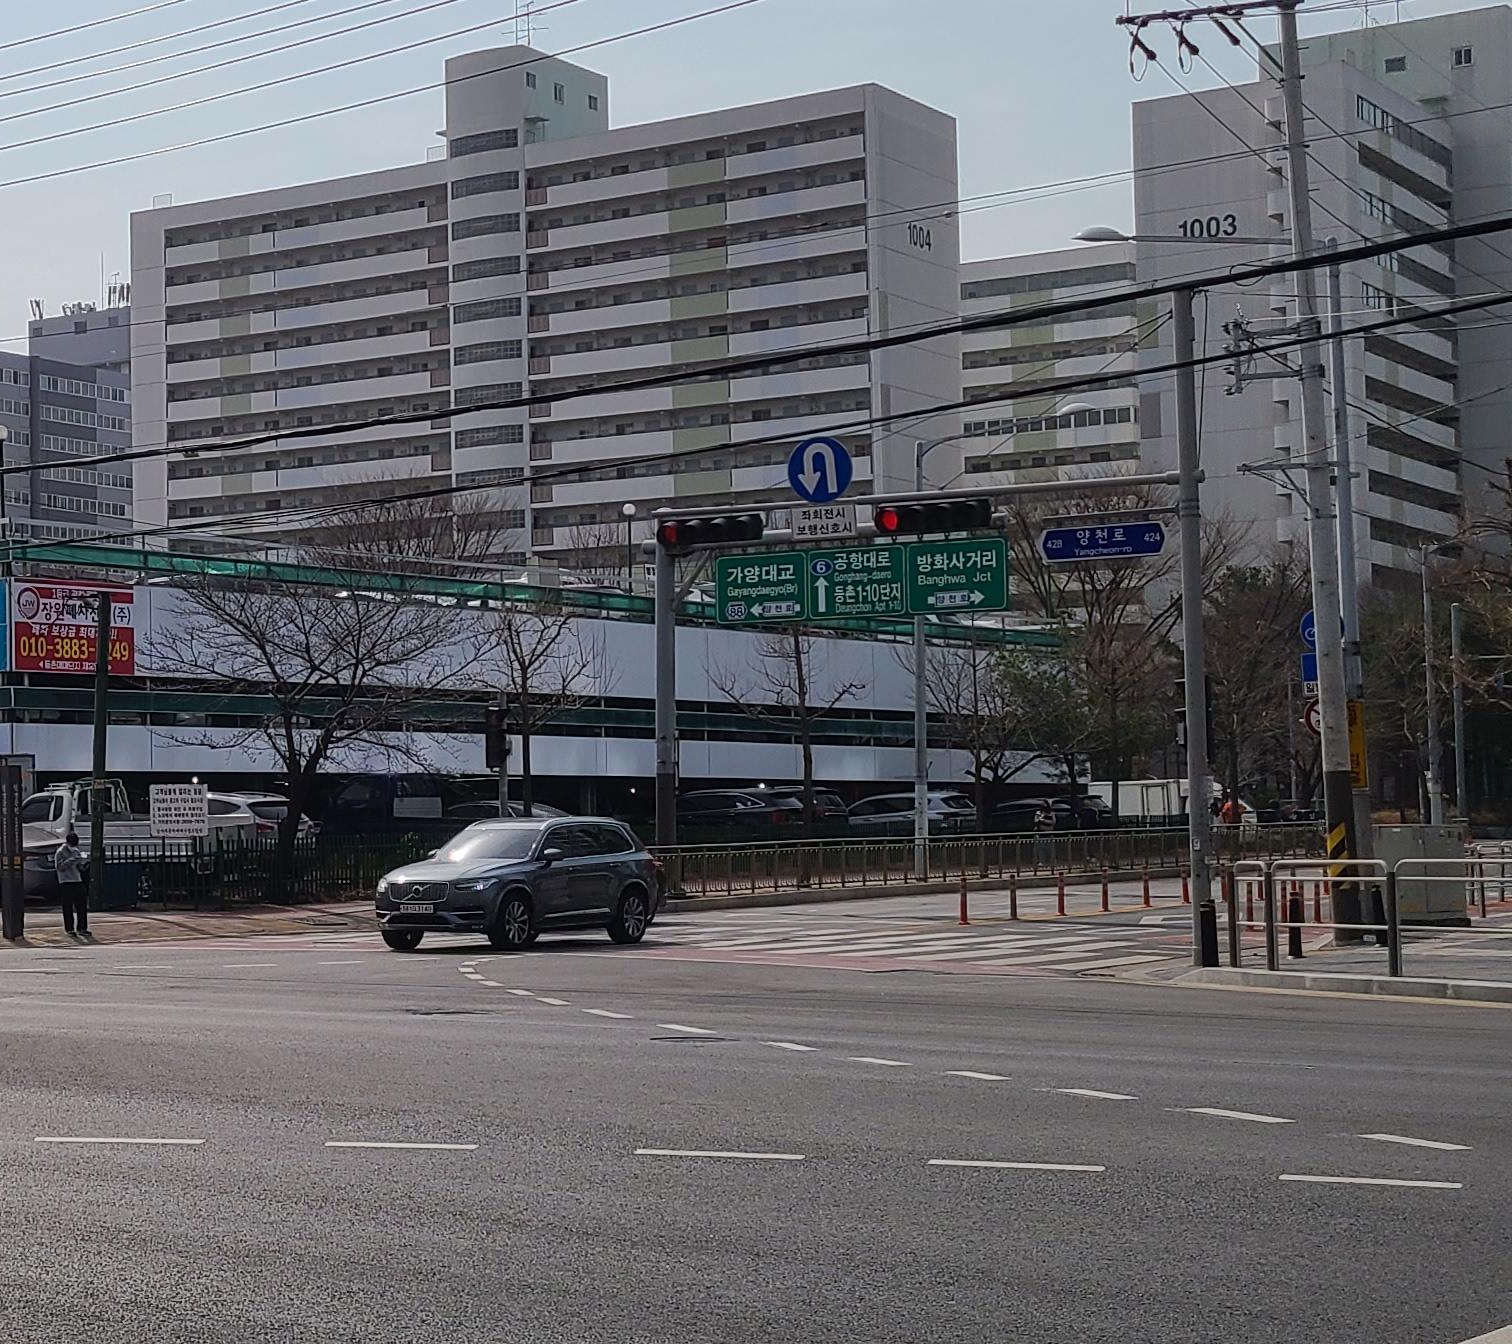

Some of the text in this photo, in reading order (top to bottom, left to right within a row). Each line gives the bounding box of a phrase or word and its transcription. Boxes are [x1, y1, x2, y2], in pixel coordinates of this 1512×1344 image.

[1178, 214, 1238, 238] 1003
[908, 222, 932, 252] 1004
[800, 507, 846, 521] 좌회전시
[797, 521, 852, 536] 보행신호시
[1076, 528, 1127, 546] 양천로
[1143, 532, 1161, 542] 424
[816, 561, 827, 574] 6
[833, 551, 892, 570] 공항대로
[917, 549, 996, 572] 방화사거리
[726, 564, 796, 584] 가양대교
[917, 571, 992, 587] Banghwa Jct
[22, 599, 35, 608] JW
[728, 606, 745, 617] 88
[112, 605, 131, 625] (주)
[51, 624, 76, 638] 보상금
[20, 636, 130, 661] 010-3883-49
